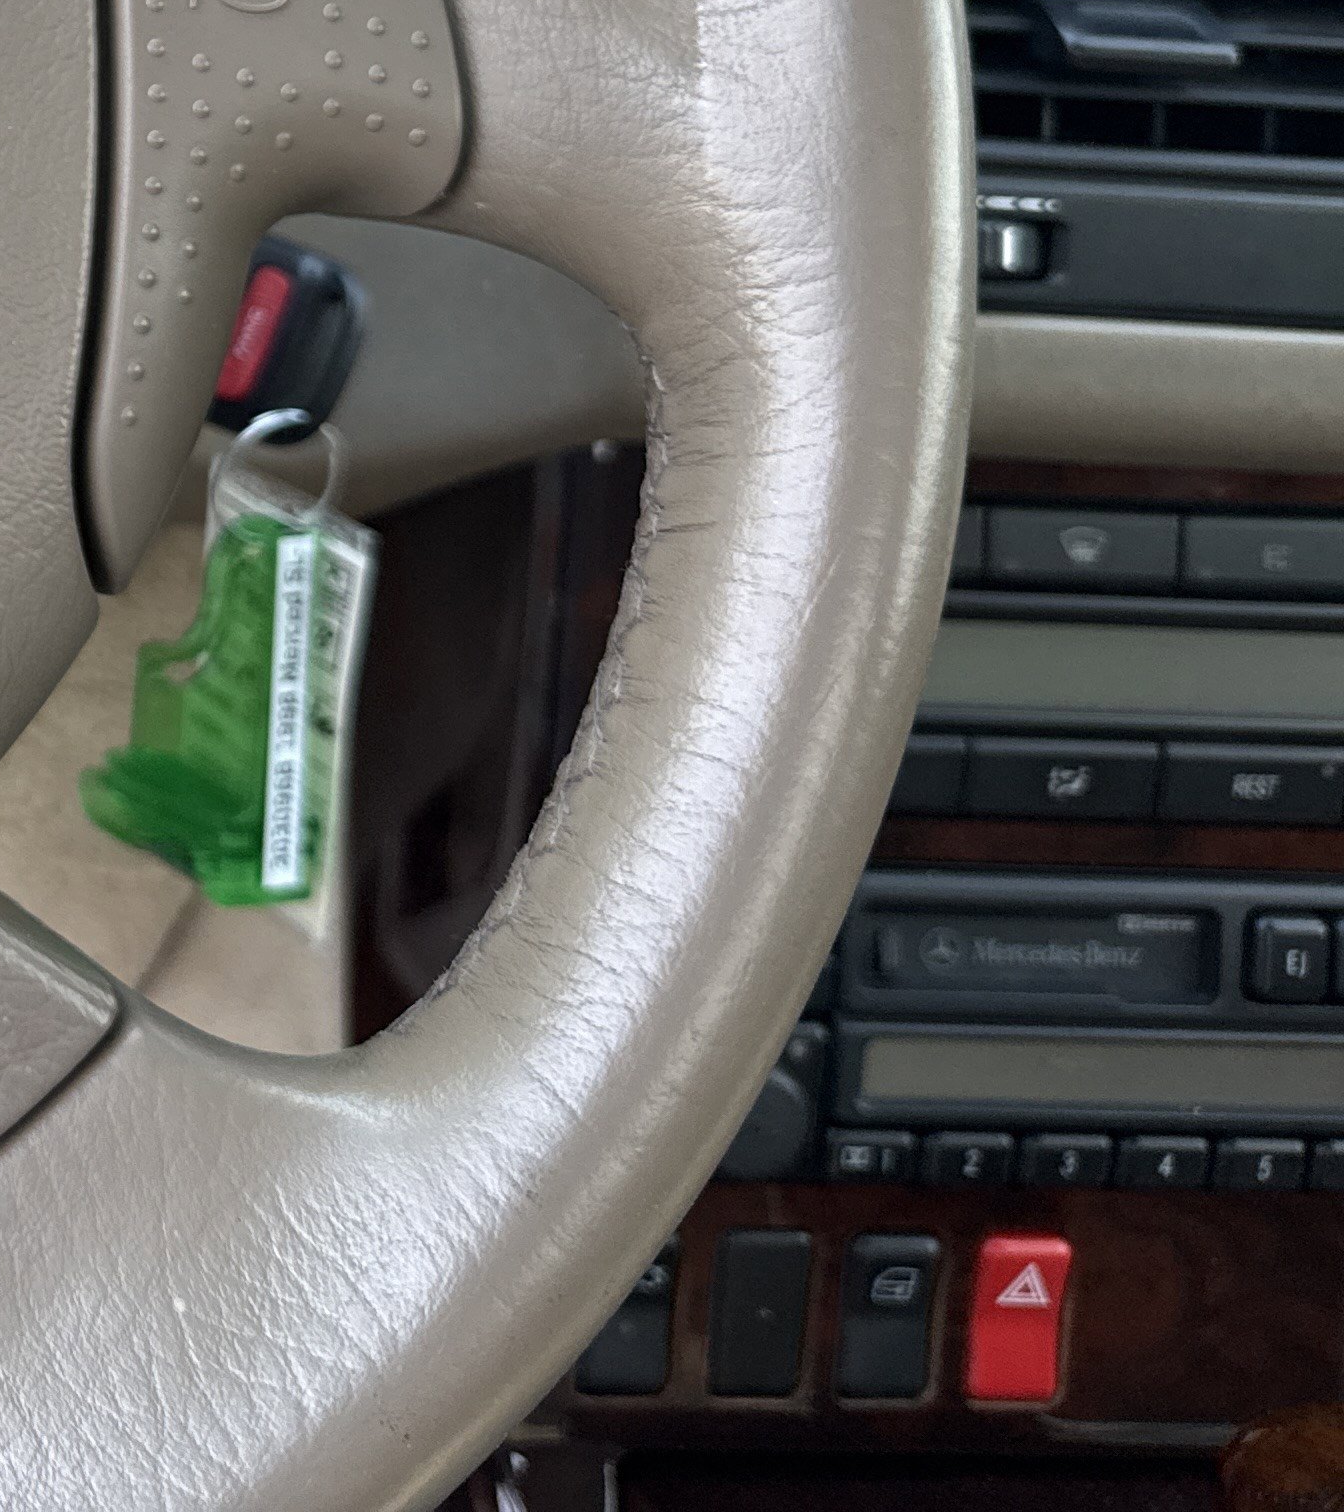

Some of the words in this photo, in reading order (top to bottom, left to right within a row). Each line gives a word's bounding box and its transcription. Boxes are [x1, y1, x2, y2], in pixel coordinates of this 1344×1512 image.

[963, 1150, 979, 1177] 2
[1060, 1151, 1076, 1178] 3
[1157, 1152, 1174, 1178] 4
[1257, 1154, 1273, 1180] 5
